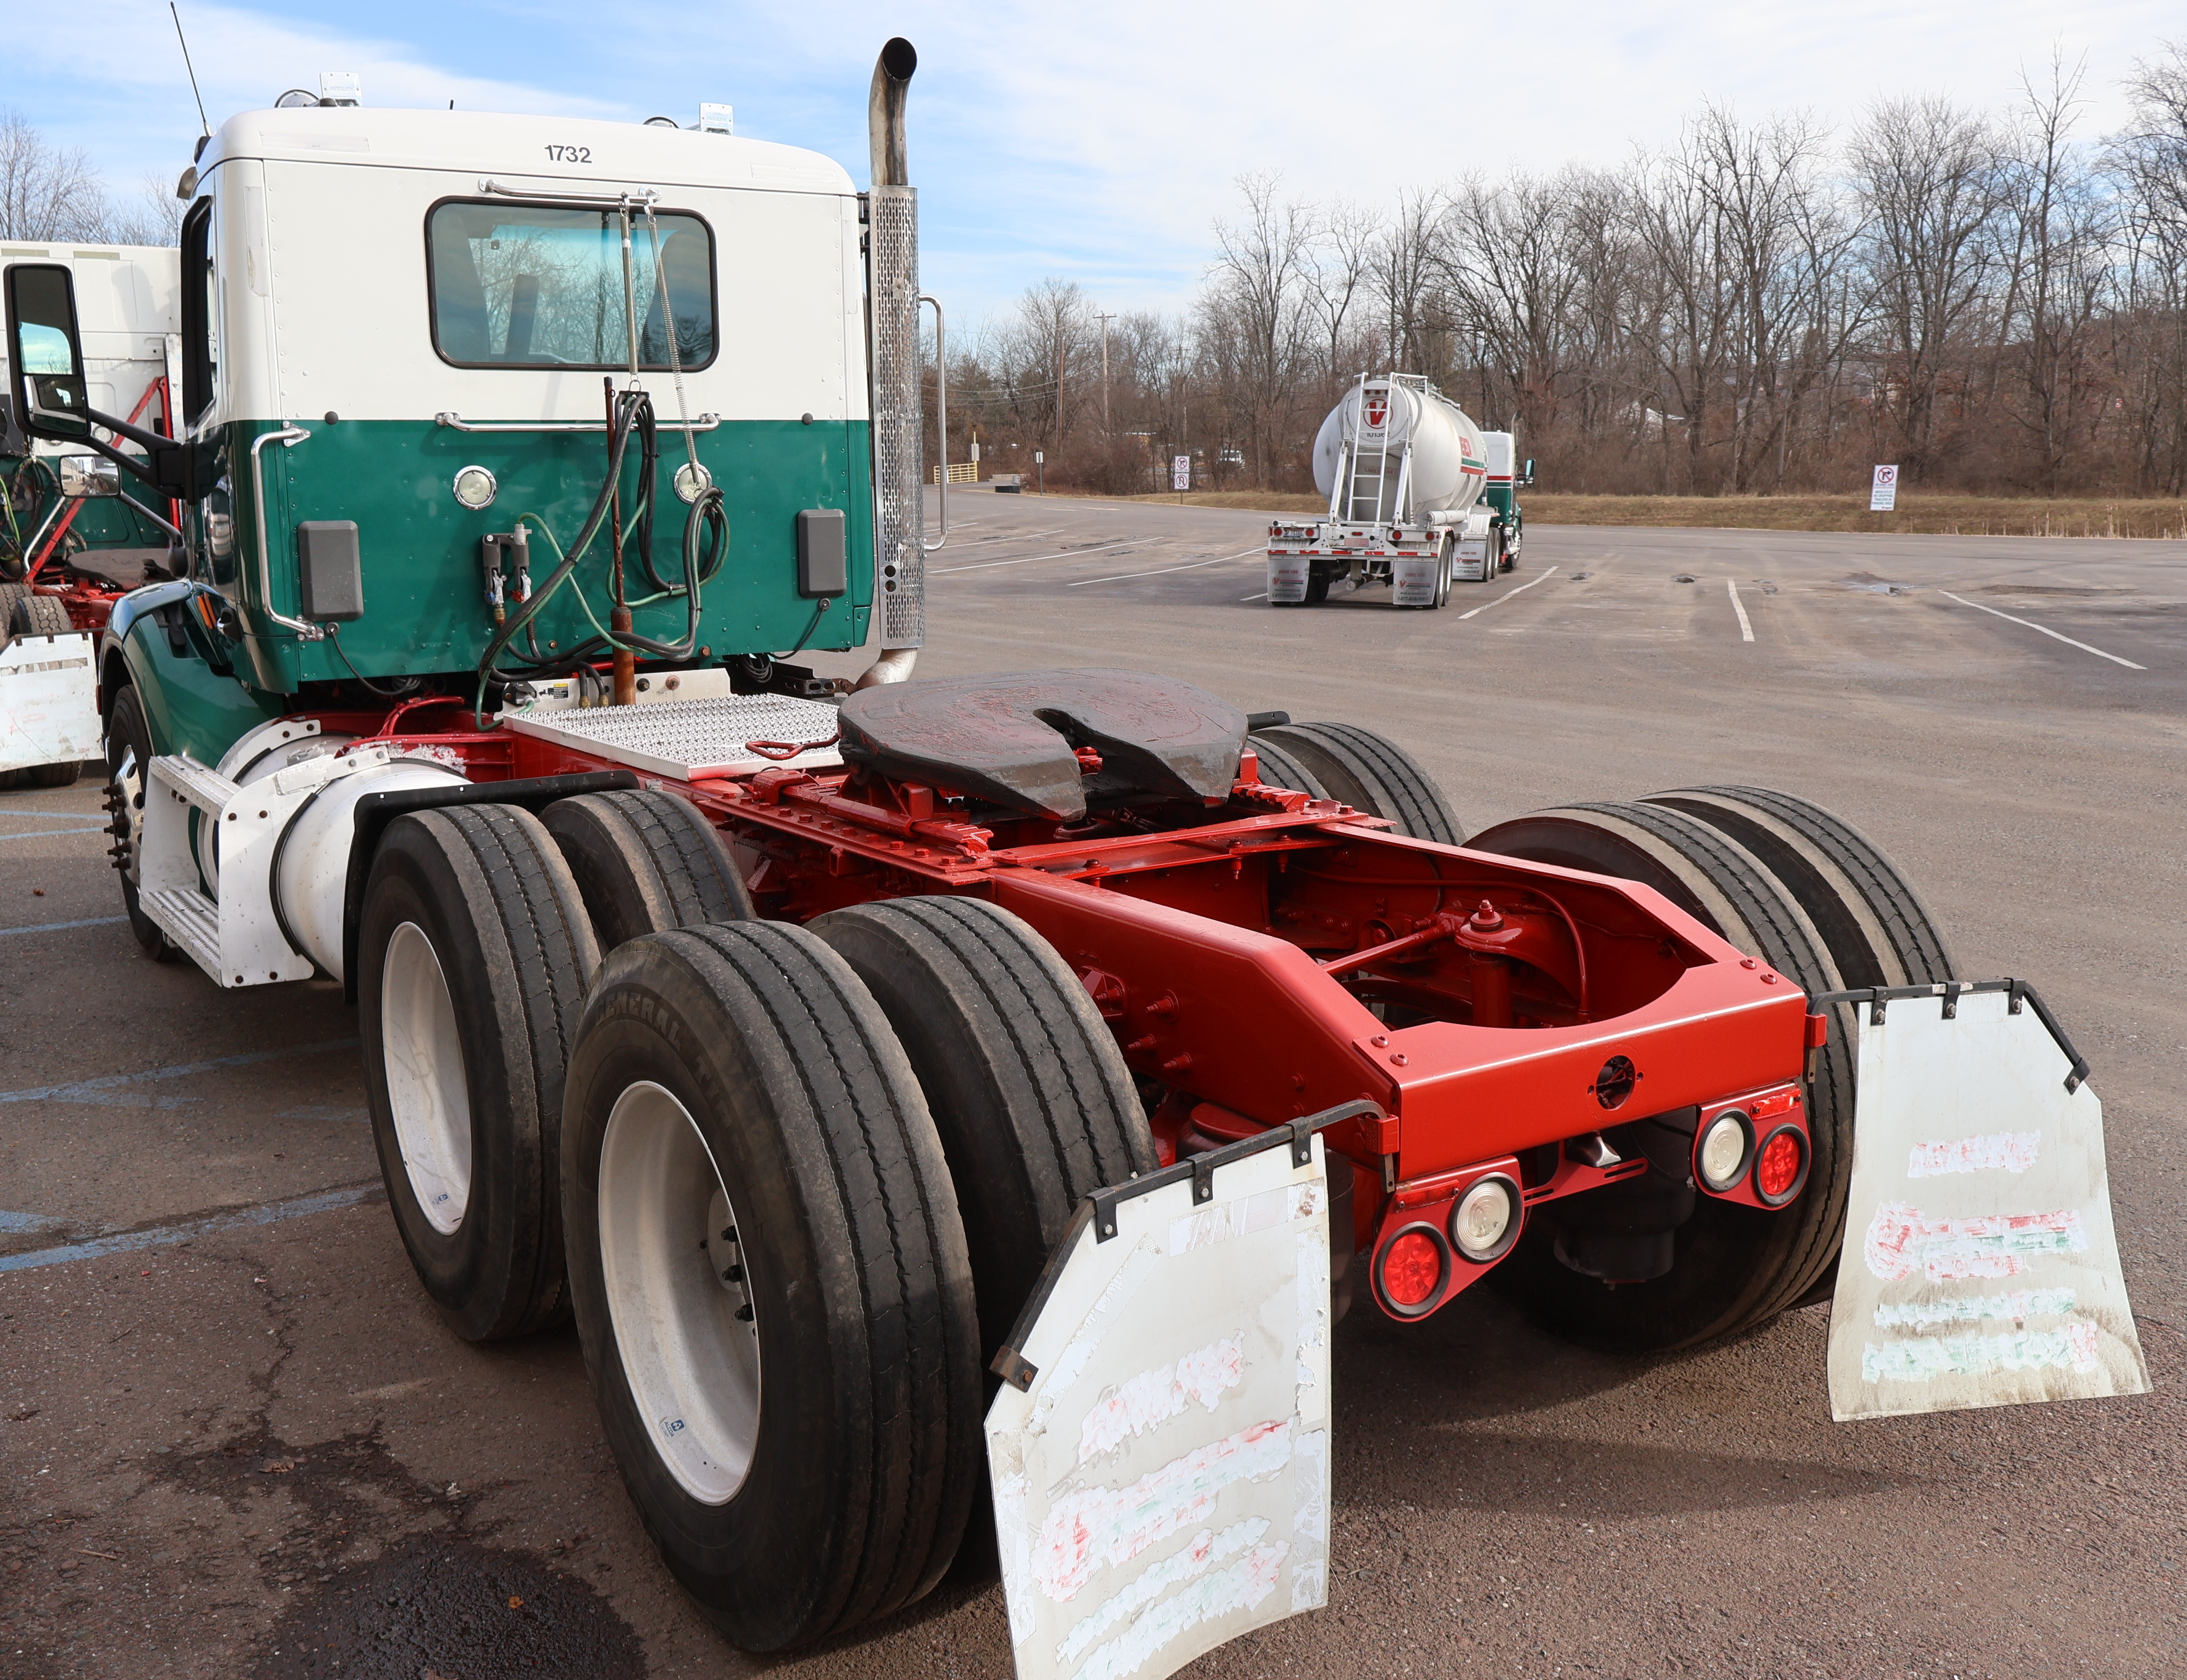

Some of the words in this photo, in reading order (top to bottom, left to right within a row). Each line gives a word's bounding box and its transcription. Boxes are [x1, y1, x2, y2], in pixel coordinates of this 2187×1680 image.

[544, 144, 592, 163] 1732
[1369, 402, 1388, 425] V
[595, 992, 681, 1052] GENERAL
[664, 1421, 674, 1438] ALCOA
